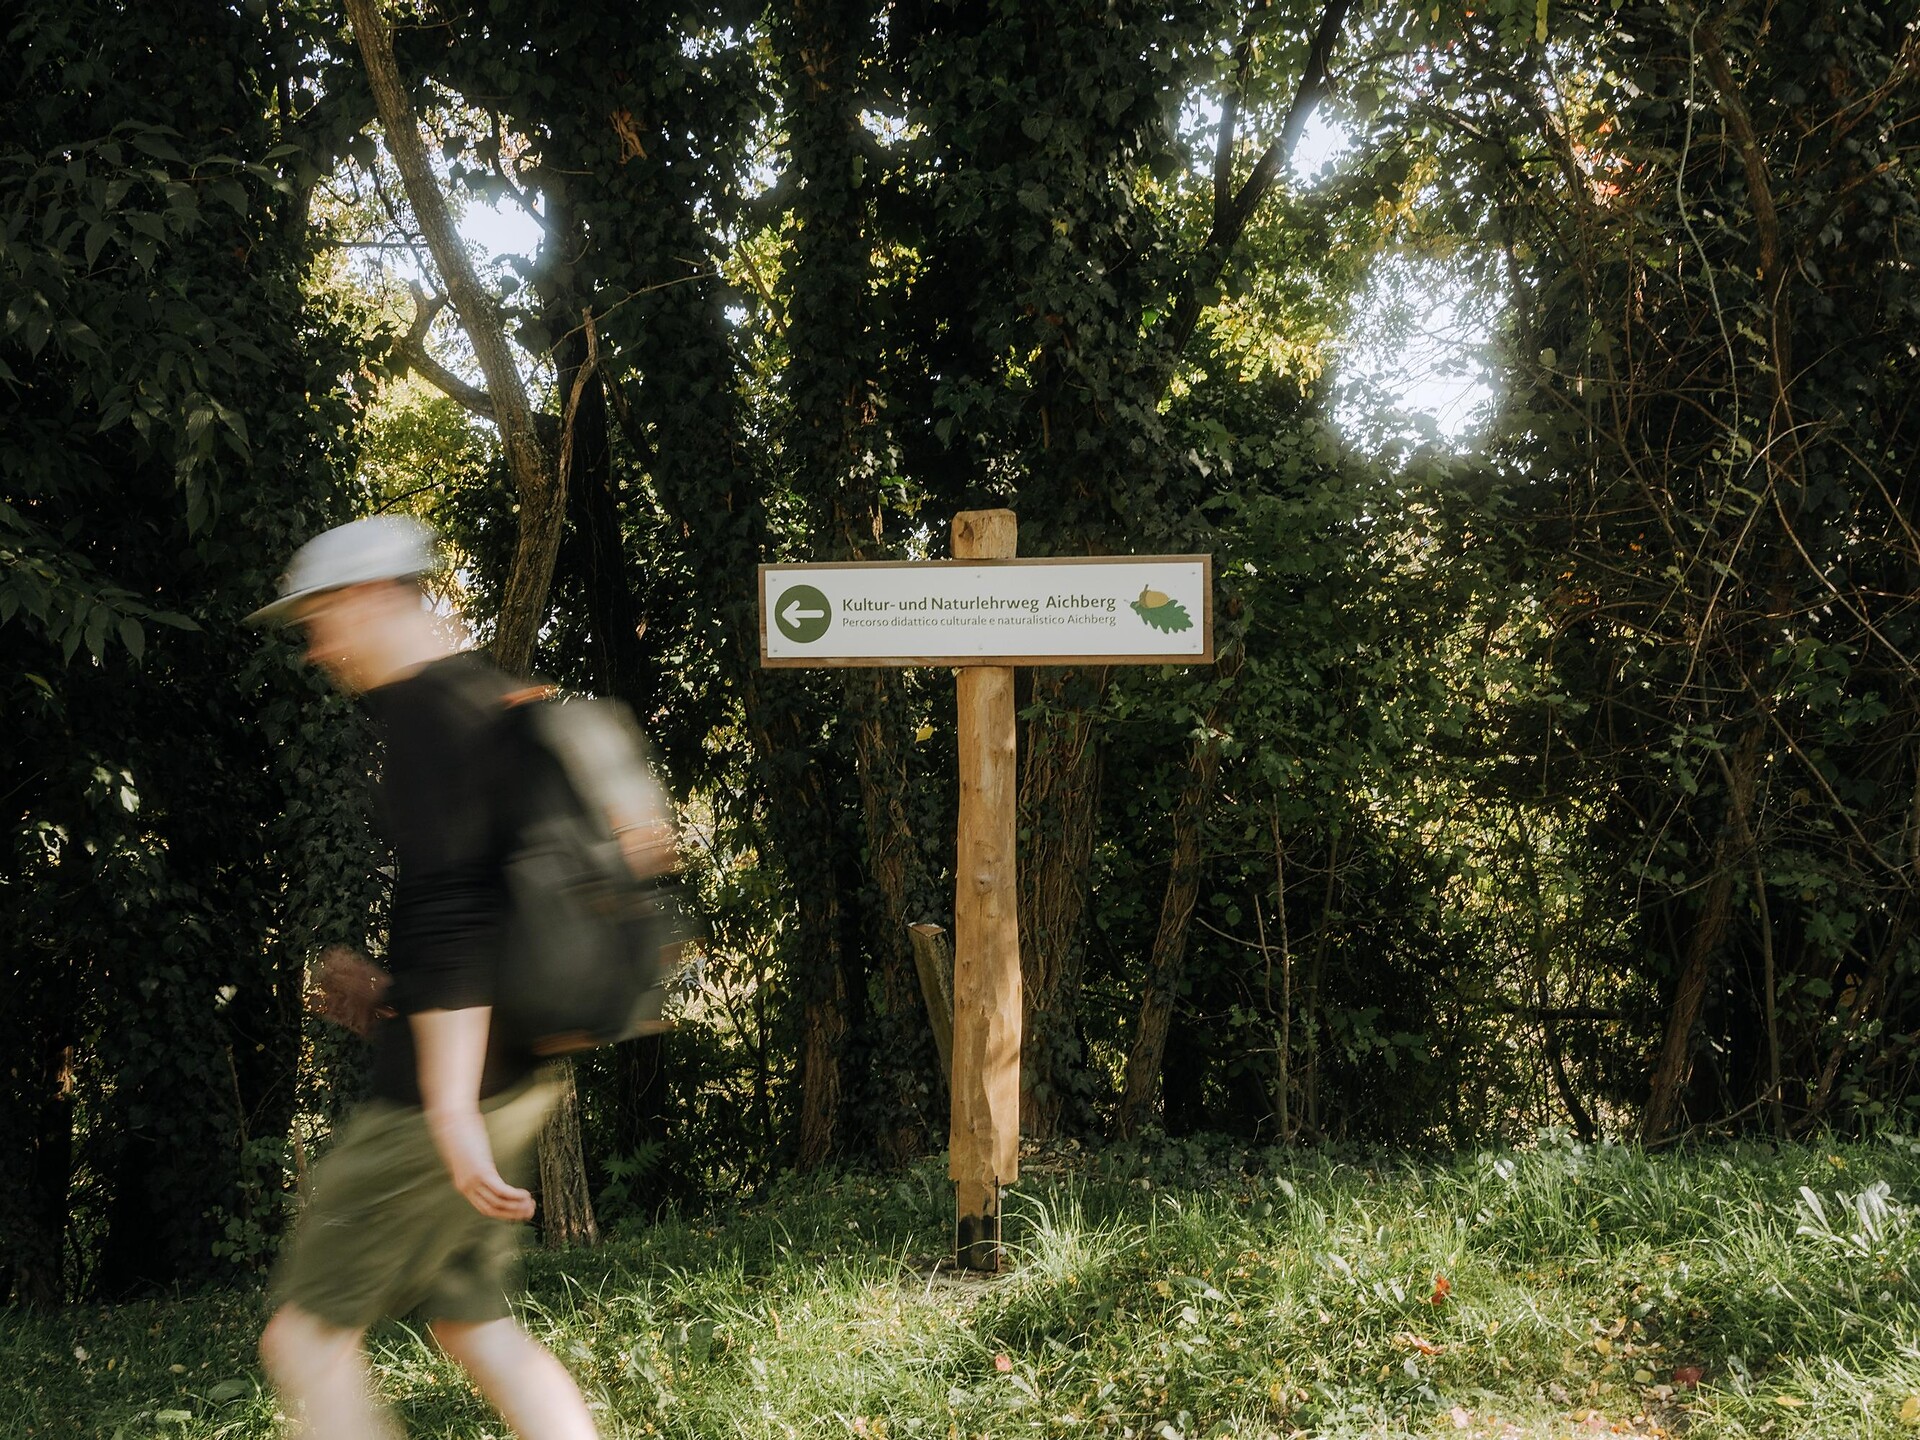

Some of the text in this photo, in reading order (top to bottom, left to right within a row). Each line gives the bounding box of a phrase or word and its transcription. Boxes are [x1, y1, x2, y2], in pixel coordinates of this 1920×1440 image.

[842, 595, 1116, 613] Kultur- und Naturlehrweg Aichberg
[842, 613, 1116, 627] Percorso didattico culturale e naturalistico Aichberg
